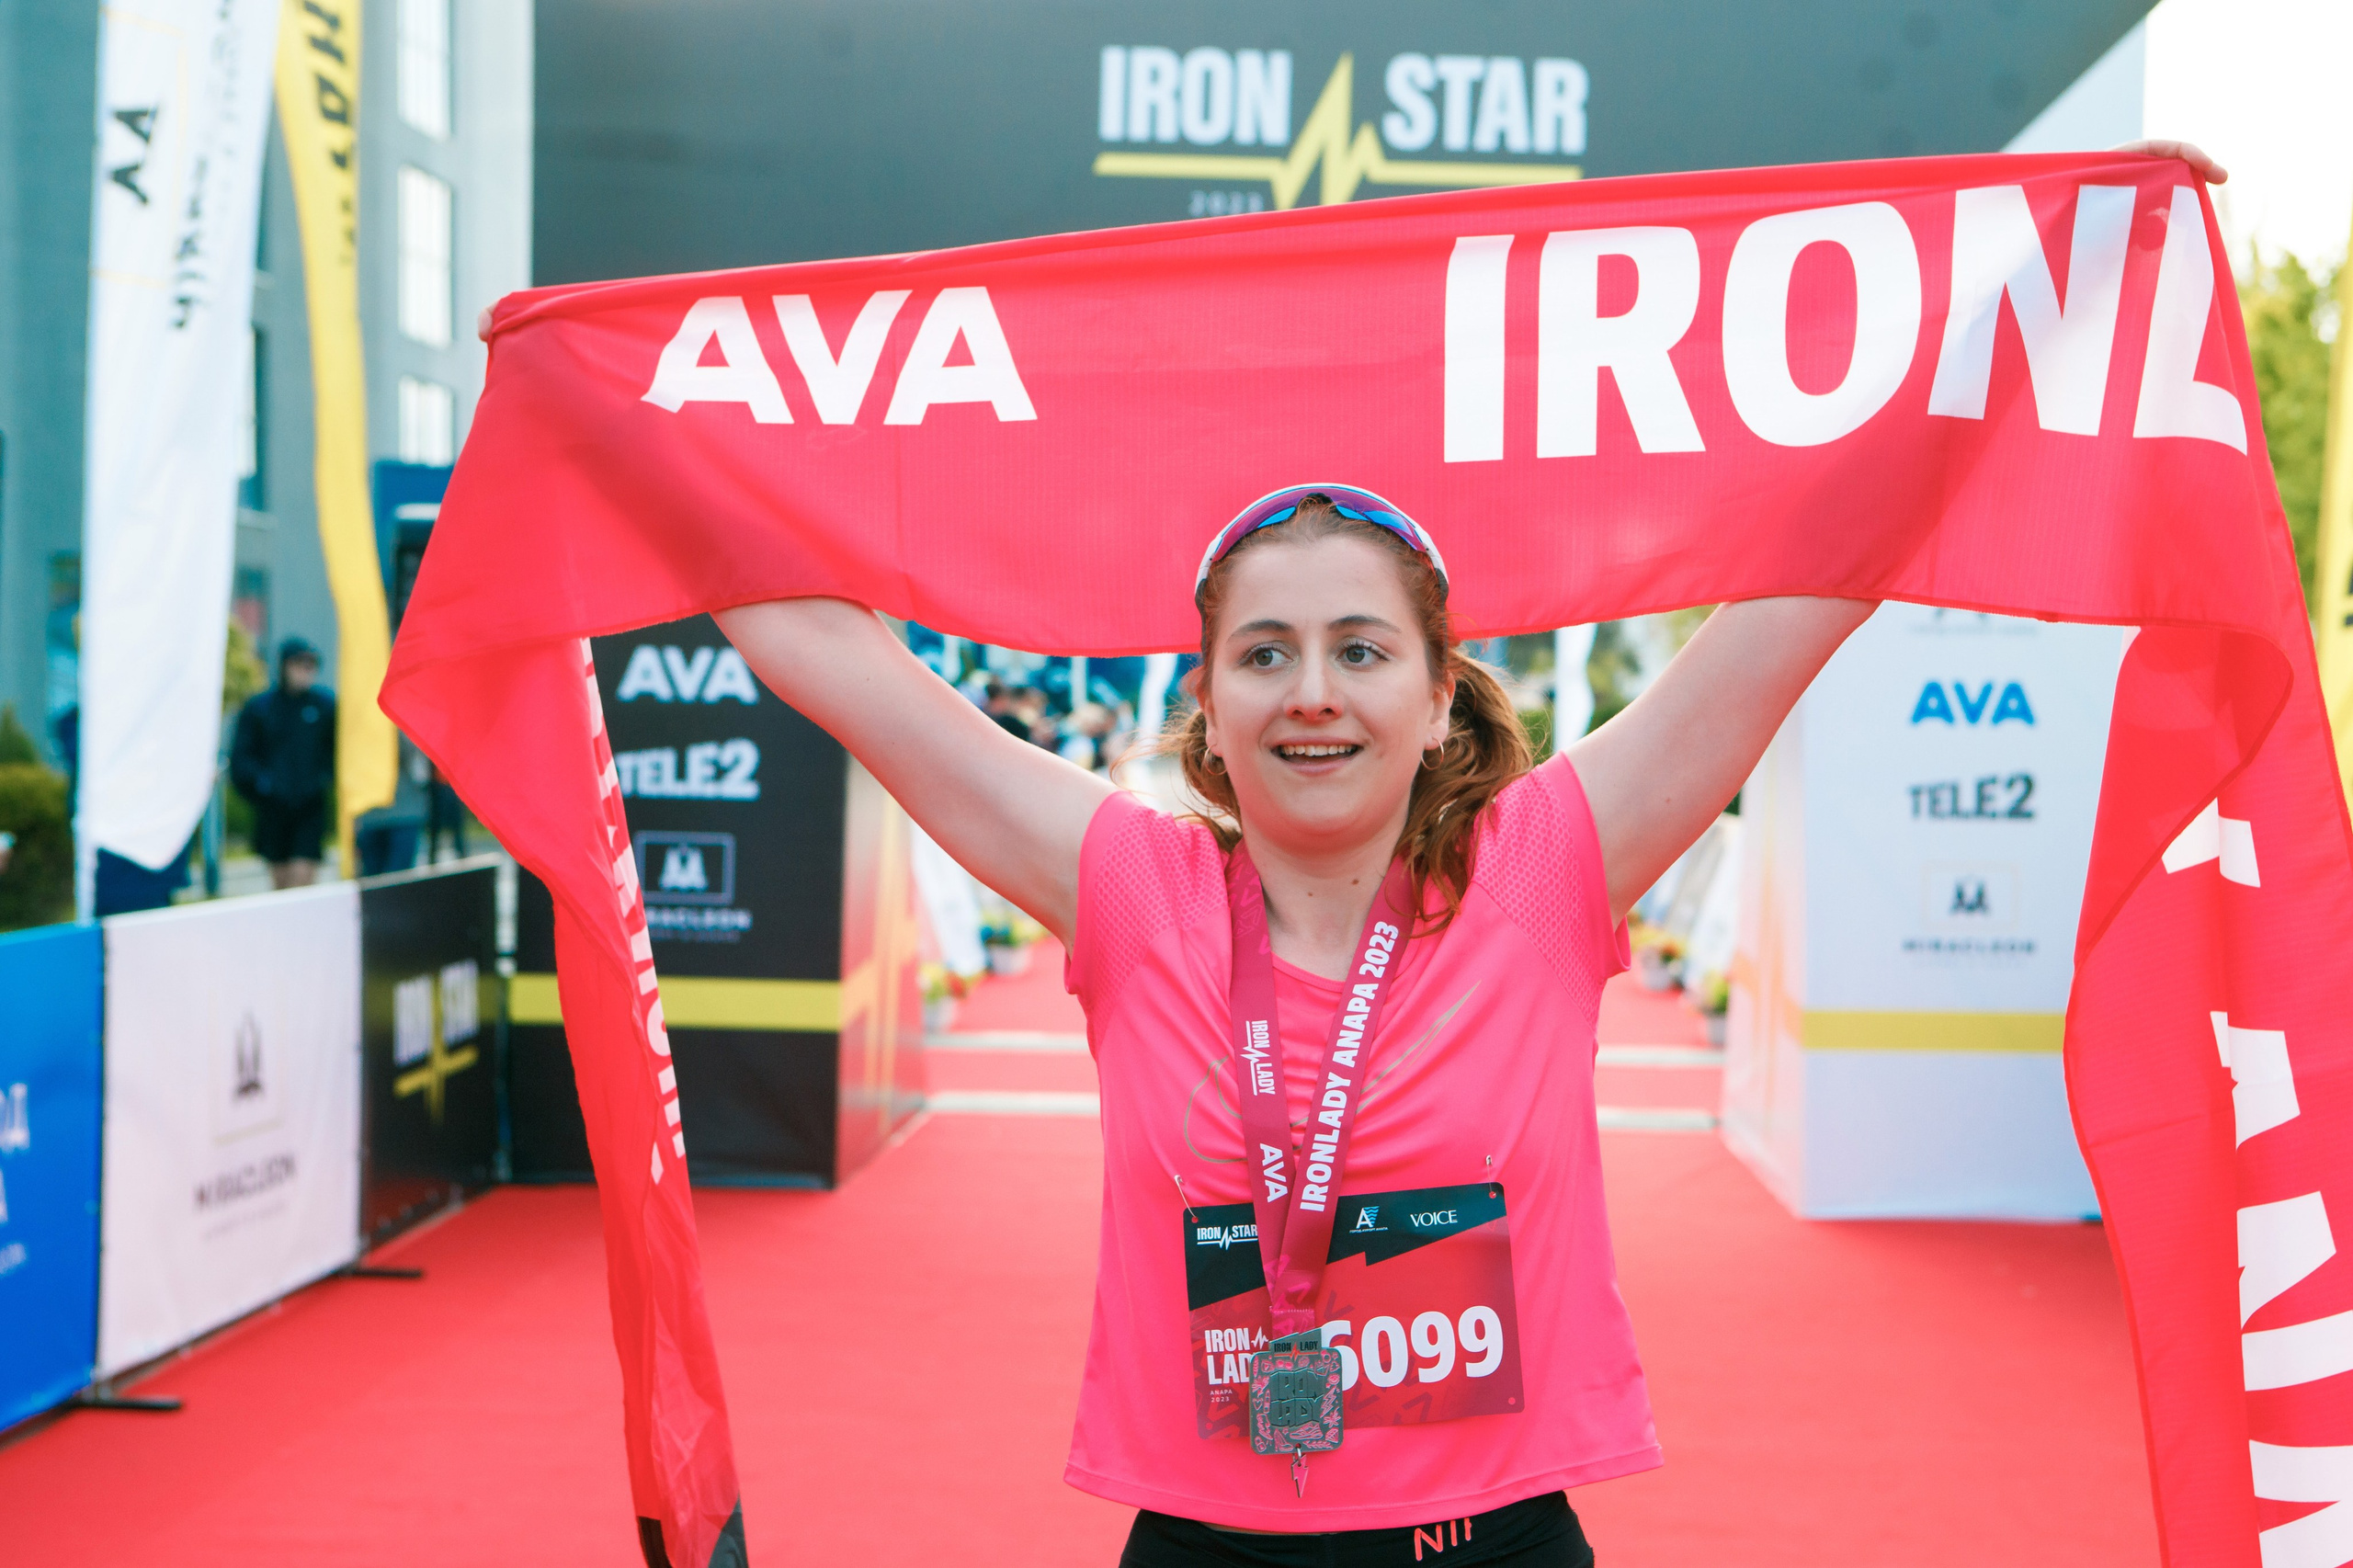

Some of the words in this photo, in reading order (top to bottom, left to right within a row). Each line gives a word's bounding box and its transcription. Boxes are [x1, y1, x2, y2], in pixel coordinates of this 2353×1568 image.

[1098, 44, 1291, 146] IRON
[1382, 51, 1589, 155] STAR
[641, 286, 1038, 426] AVA
[616, 644, 759, 705] AVA
[1910, 682, 2035, 725] AVA
[614, 738, 760, 801] TELE2
[1908, 773, 2036, 820] TELE2
[1251, 1020, 1270, 1049] IRON
[1255, 1062, 1276, 1095] LADY
[1300, 1072, 1351, 1211] IRONLADY
[1333, 983, 1379, 1068] ANAPA
[1359, 921, 1400, 979] 2023
[1259, 1142, 1288, 1202] AVA
[1197, 1226, 1222, 1241] IRON
[1232, 1224, 1258, 1238] STAR
[1410, 1210, 1458, 1227] VOICE
[1204, 1327, 1250, 1353] IRON
[1274, 1343, 1291, 1352] IRON
[1300, 1341, 1318, 1350] LADY
[1207, 1353, 1251, 1385] LAD
